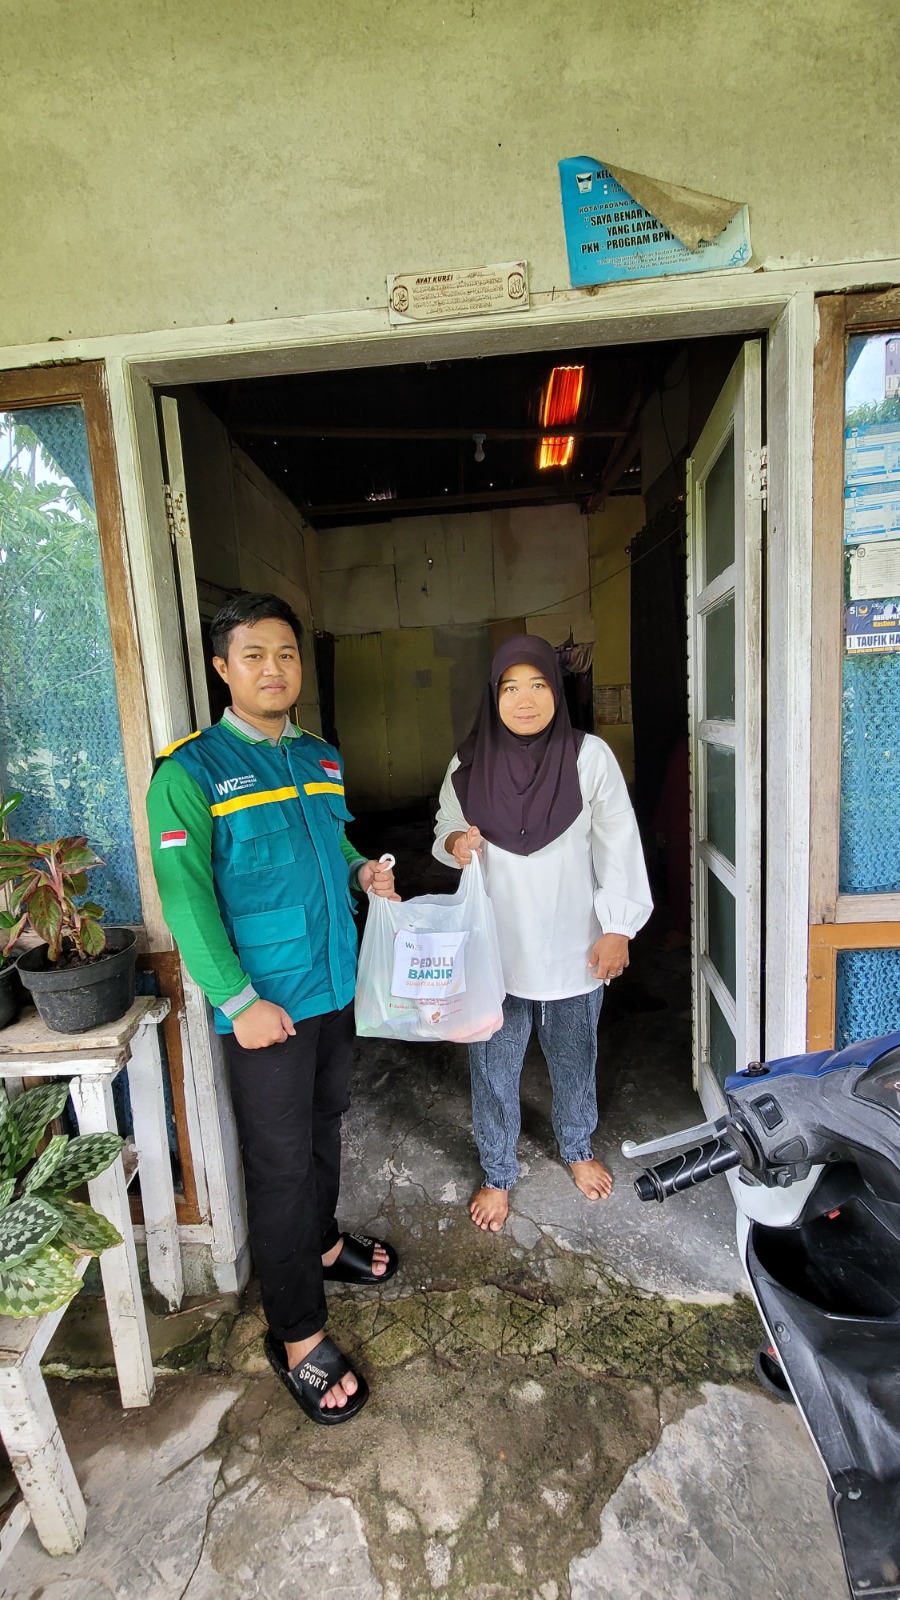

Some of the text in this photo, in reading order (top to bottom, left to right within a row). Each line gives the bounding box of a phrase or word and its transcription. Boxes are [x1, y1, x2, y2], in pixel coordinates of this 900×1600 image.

[579, 205, 598, 214] KOTA
[600, 200, 629, 210] PADANG
[590, 213, 612, 227] SAYA
[614, 208, 643, 223] BENAR
[607, 224, 630, 237] YANG
[631, 219, 658, 233] LAYAK
[581, 242, 600, 254] PKH
[606, 234, 651, 250] PROGRAM
[416, 276, 432, 285] AYAT
[433, 274, 454, 283] KURSI
[849, 606, 856, 615] 5
[856, 634, 888, 647] TAUFIK
[214, 777, 239, 796] WIZ
[410, 956, 454, 968] PEDULI
[407, 968, 453, 980] BANJIR
[299, 1368, 329, 1391] SPORT
